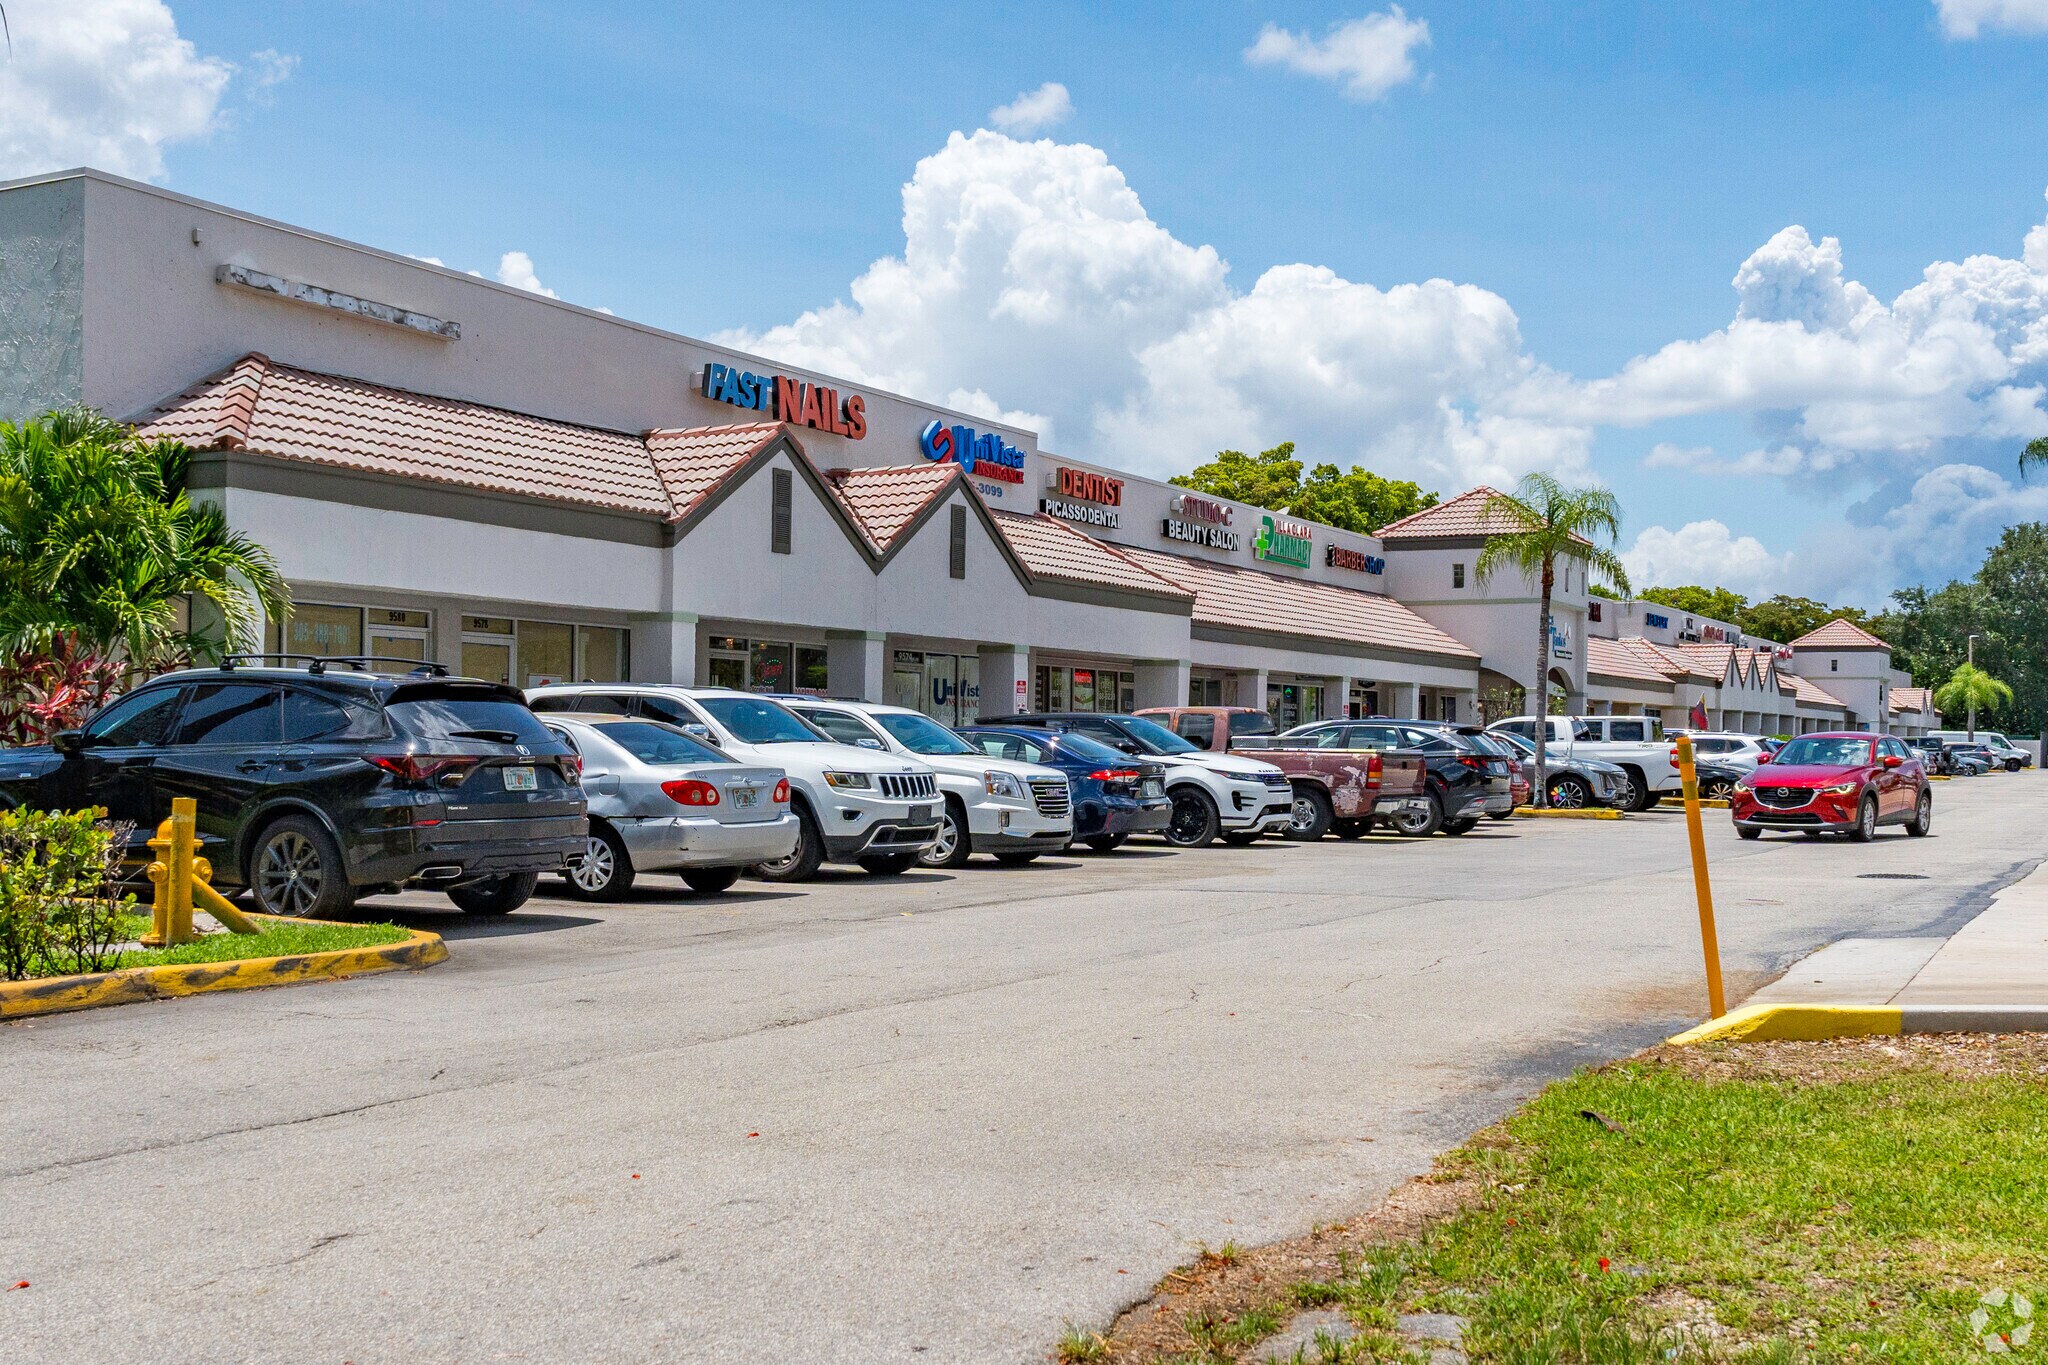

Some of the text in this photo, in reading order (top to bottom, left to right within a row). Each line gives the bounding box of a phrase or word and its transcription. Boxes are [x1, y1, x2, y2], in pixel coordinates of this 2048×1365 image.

[705, 362, 867, 441] FAST NAILS
[955, 425, 1025, 474] UniVista
[974, 460, 1024, 485] INSURANCE
[1059, 466, 1124, 507] DENTIST
[1045, 498, 1123, 529] PICASSO DENTAL
[1168, 519, 1240, 552] BEAUTY SALON
[1262, 515, 1313, 569] PHARMACY
[1291, 523, 1313, 540] CLARA
[933, 678, 980, 705] UniVist
